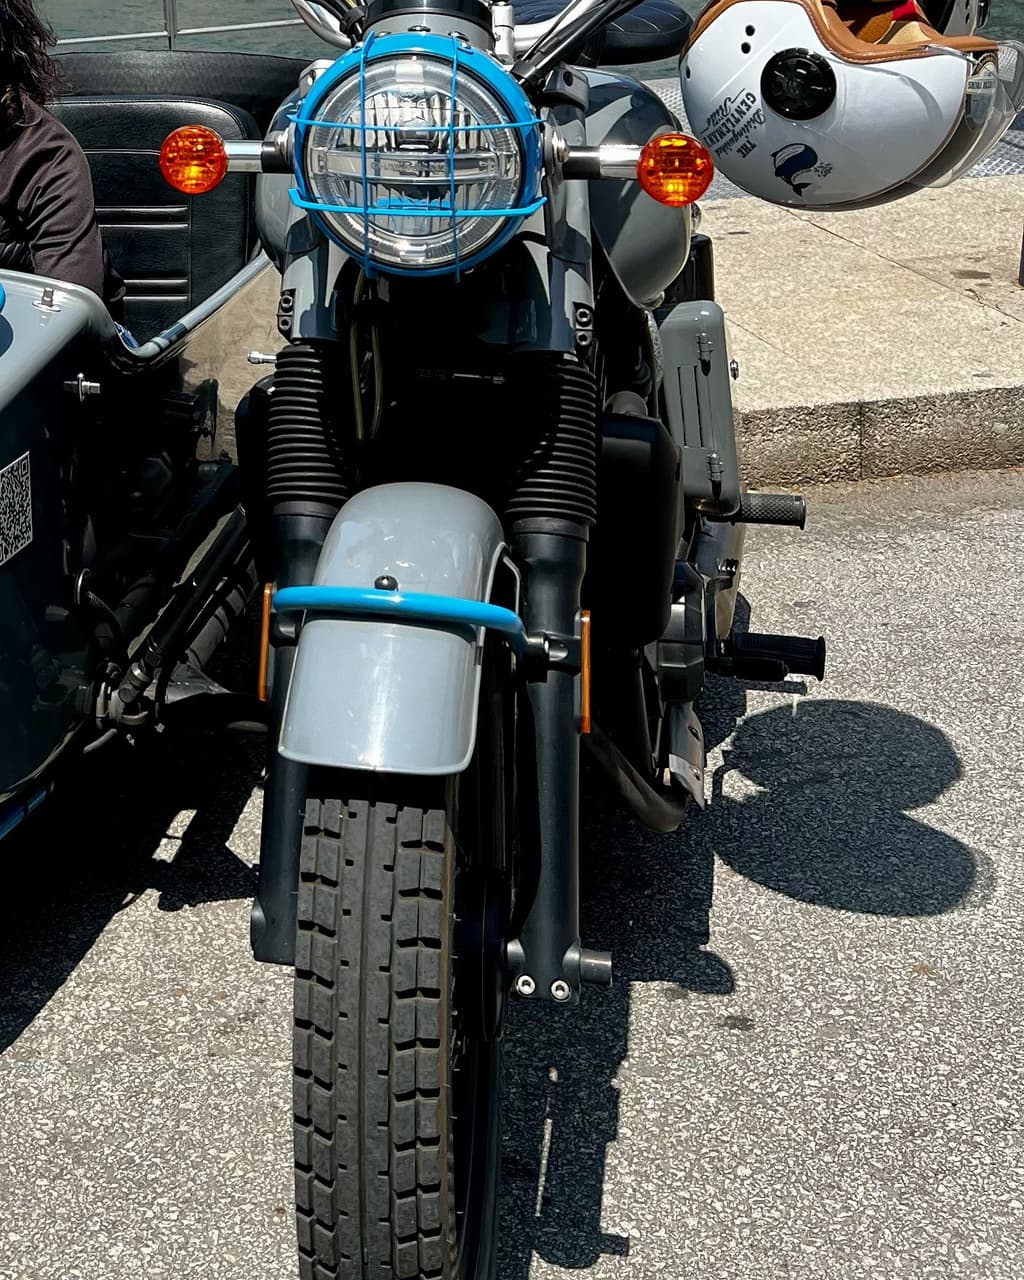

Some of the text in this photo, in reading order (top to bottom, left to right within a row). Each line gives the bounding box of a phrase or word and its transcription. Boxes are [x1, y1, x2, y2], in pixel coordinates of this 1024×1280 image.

[704, 96, 732, 130] Ride
[715, 108, 766, 159] Distinguished
[736, 139, 757, 159] THE
